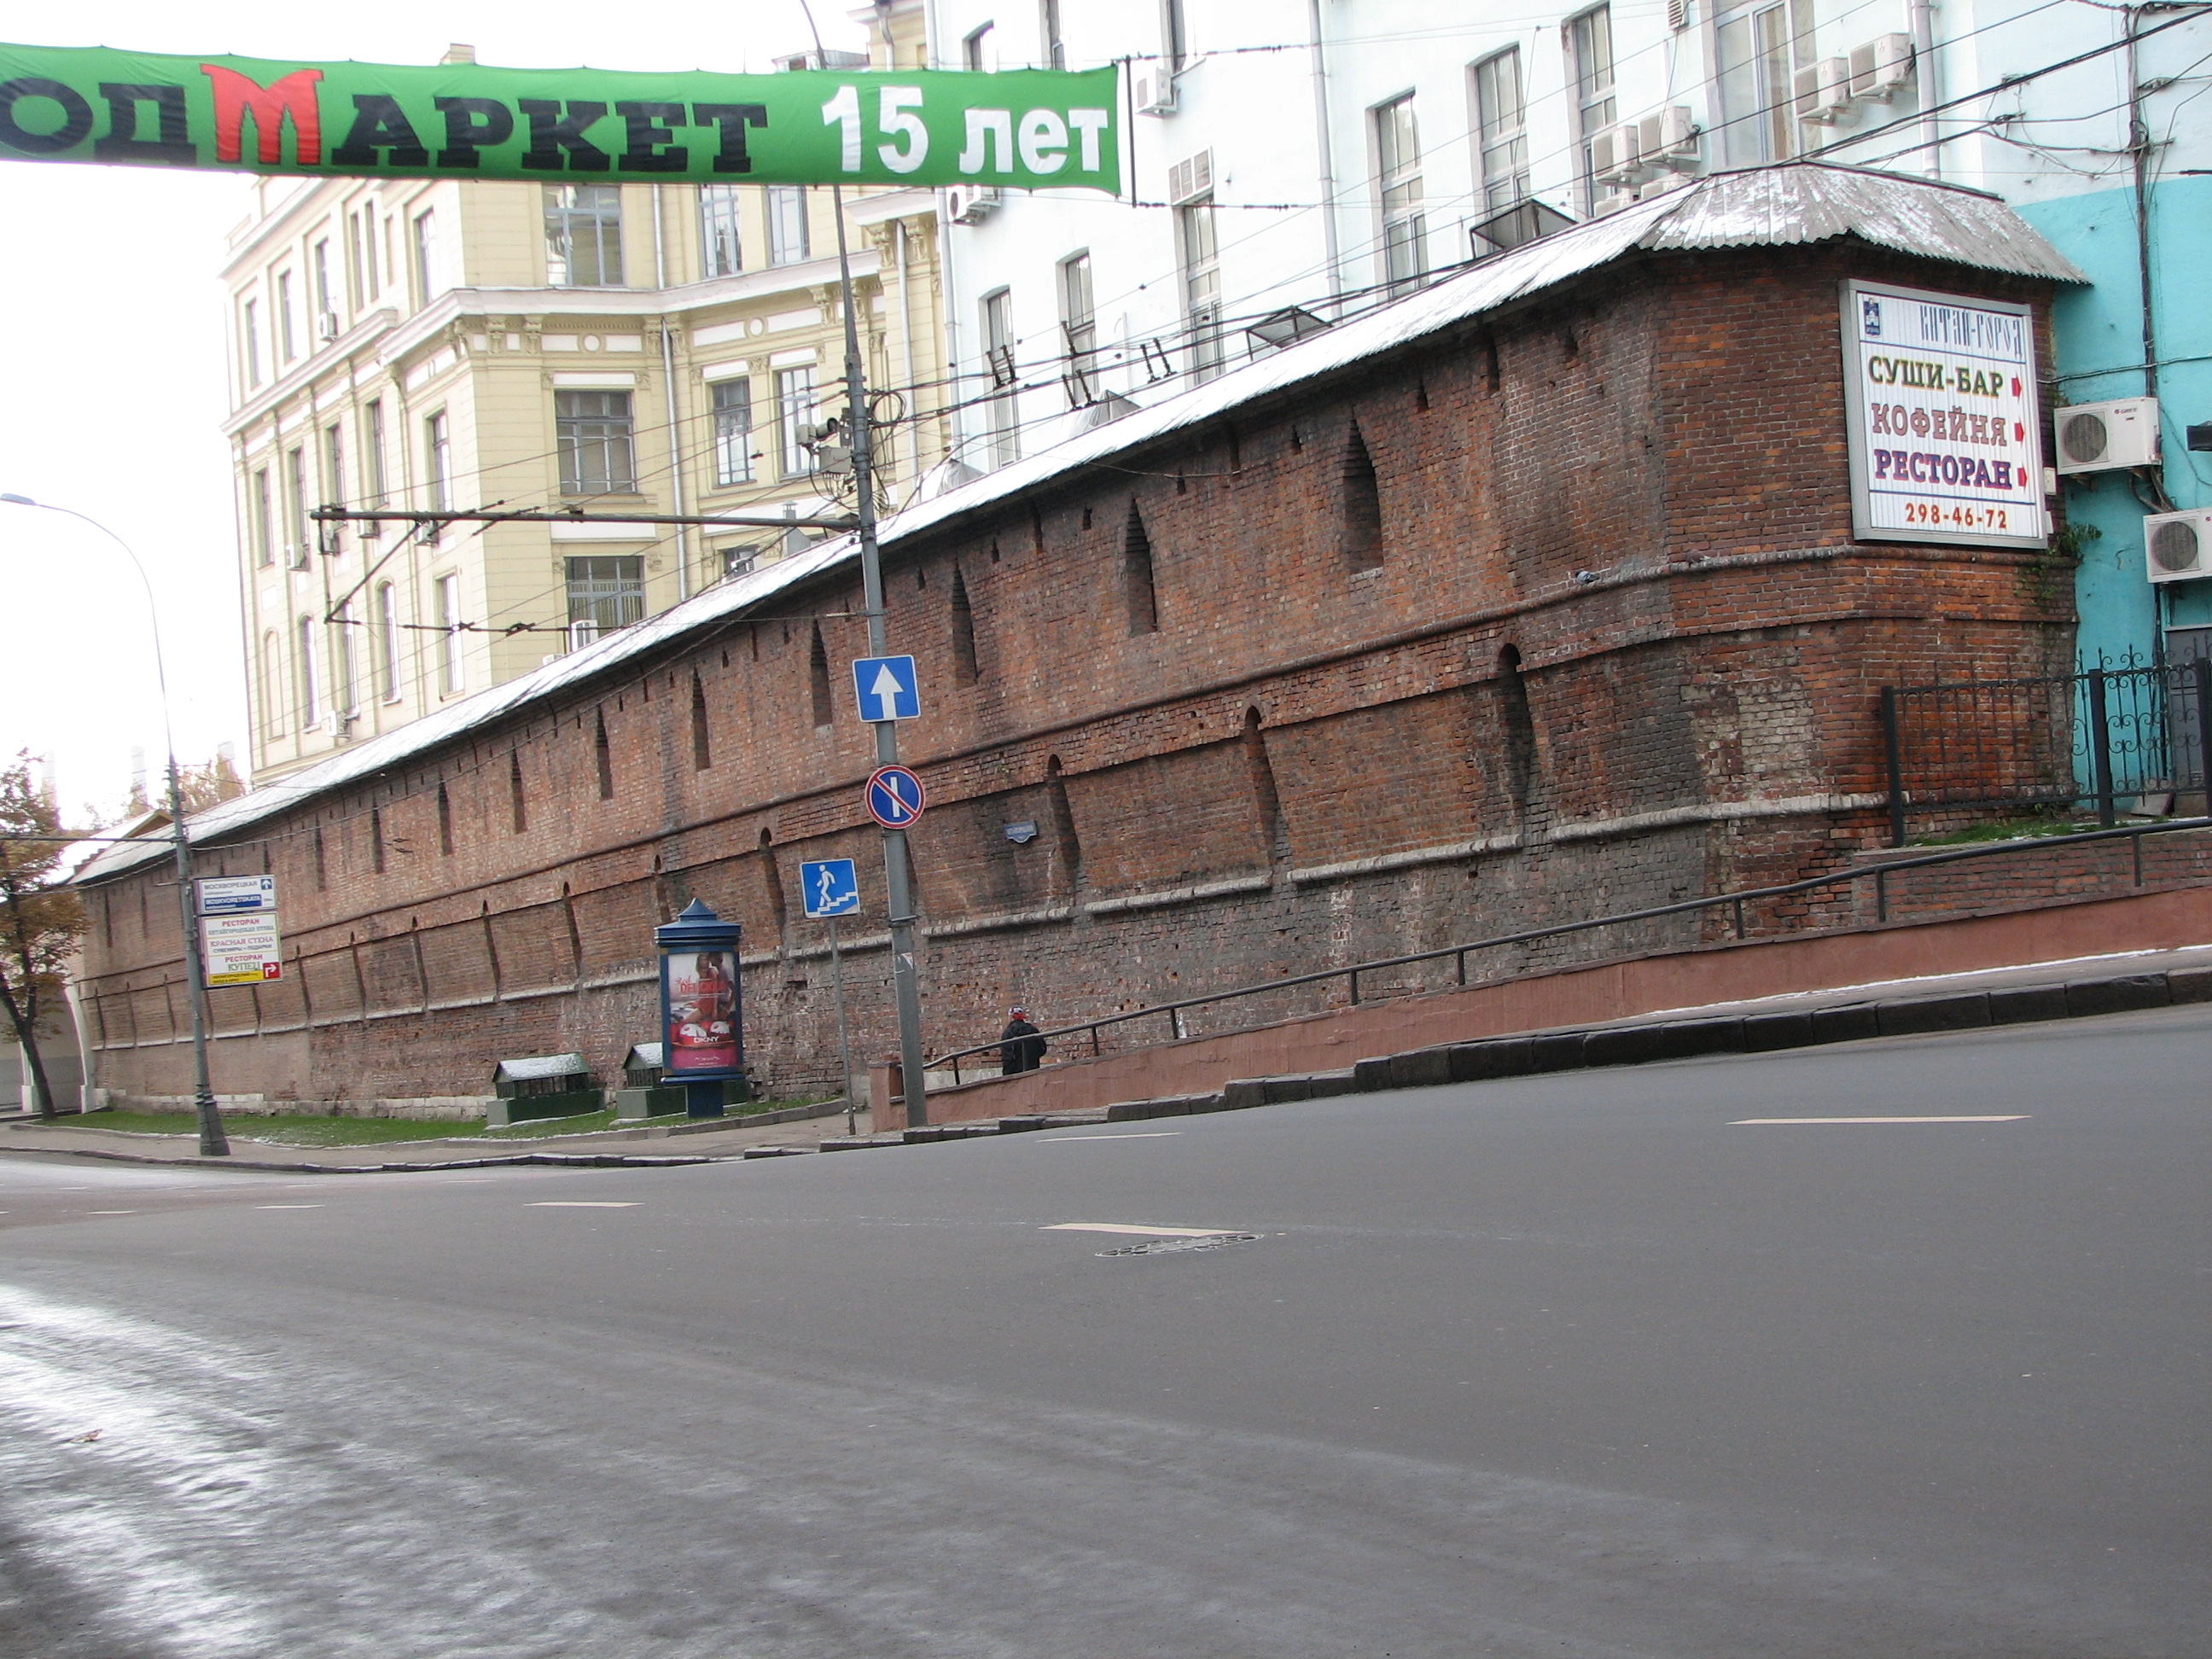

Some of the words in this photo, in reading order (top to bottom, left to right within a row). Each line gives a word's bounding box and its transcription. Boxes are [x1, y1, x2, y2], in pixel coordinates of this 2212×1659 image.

[821, 86, 929, 174] 15
[959, 108, 1108, 176] лет
[1867, 355, 2004, 398] СУШИ-БАР
[1871, 403, 2007, 446] КОФЕЙНЯ
[1874, 449, 2012, 490] РЕСТОРАН
[1905, 503, 2007, 529] 298-46-72
[222, 918, 259, 927] РЕСТОРАН
[210, 939, 246, 947] КРАСНАЯ
[224, 954, 263, 963] РЕСТОРАН
[228, 962, 260, 972] КУПЕЦ
